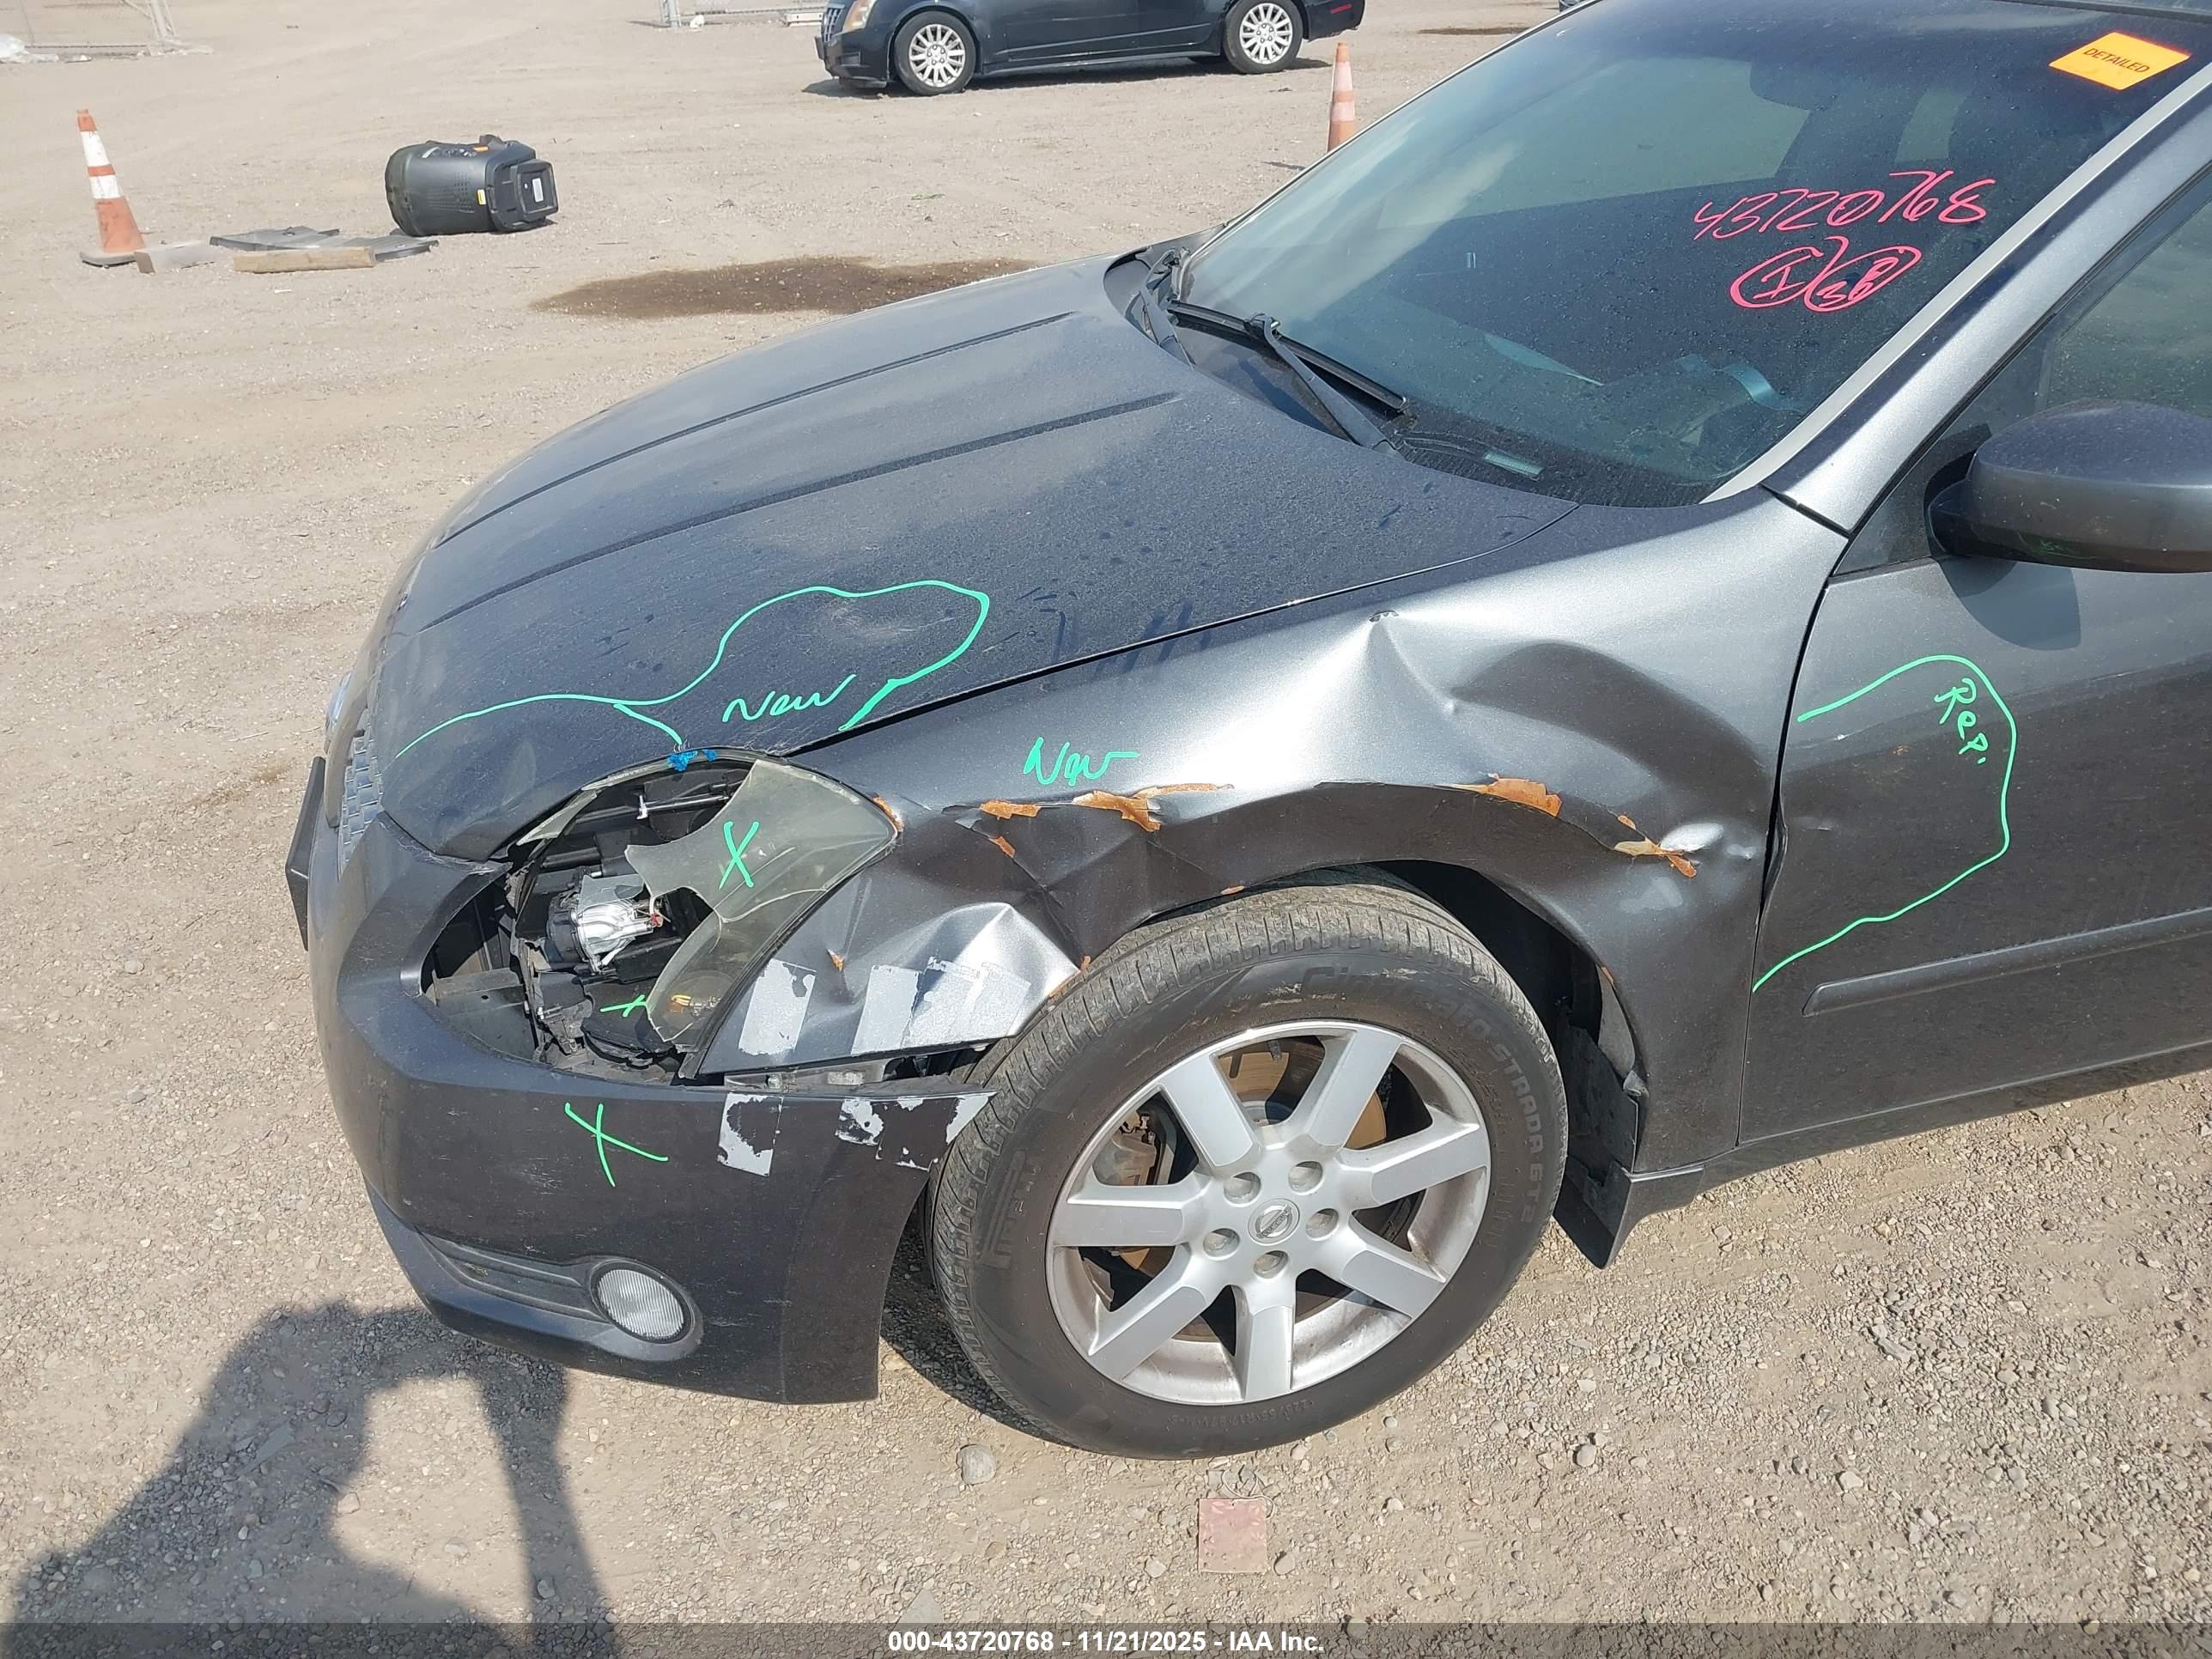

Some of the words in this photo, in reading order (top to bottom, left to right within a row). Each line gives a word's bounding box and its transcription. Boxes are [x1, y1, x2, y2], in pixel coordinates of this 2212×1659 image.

[2082, 47, 2150, 73] DETAILED
[1693, 170, 1996, 240] 43720768
[721, 673, 857, 722] New
